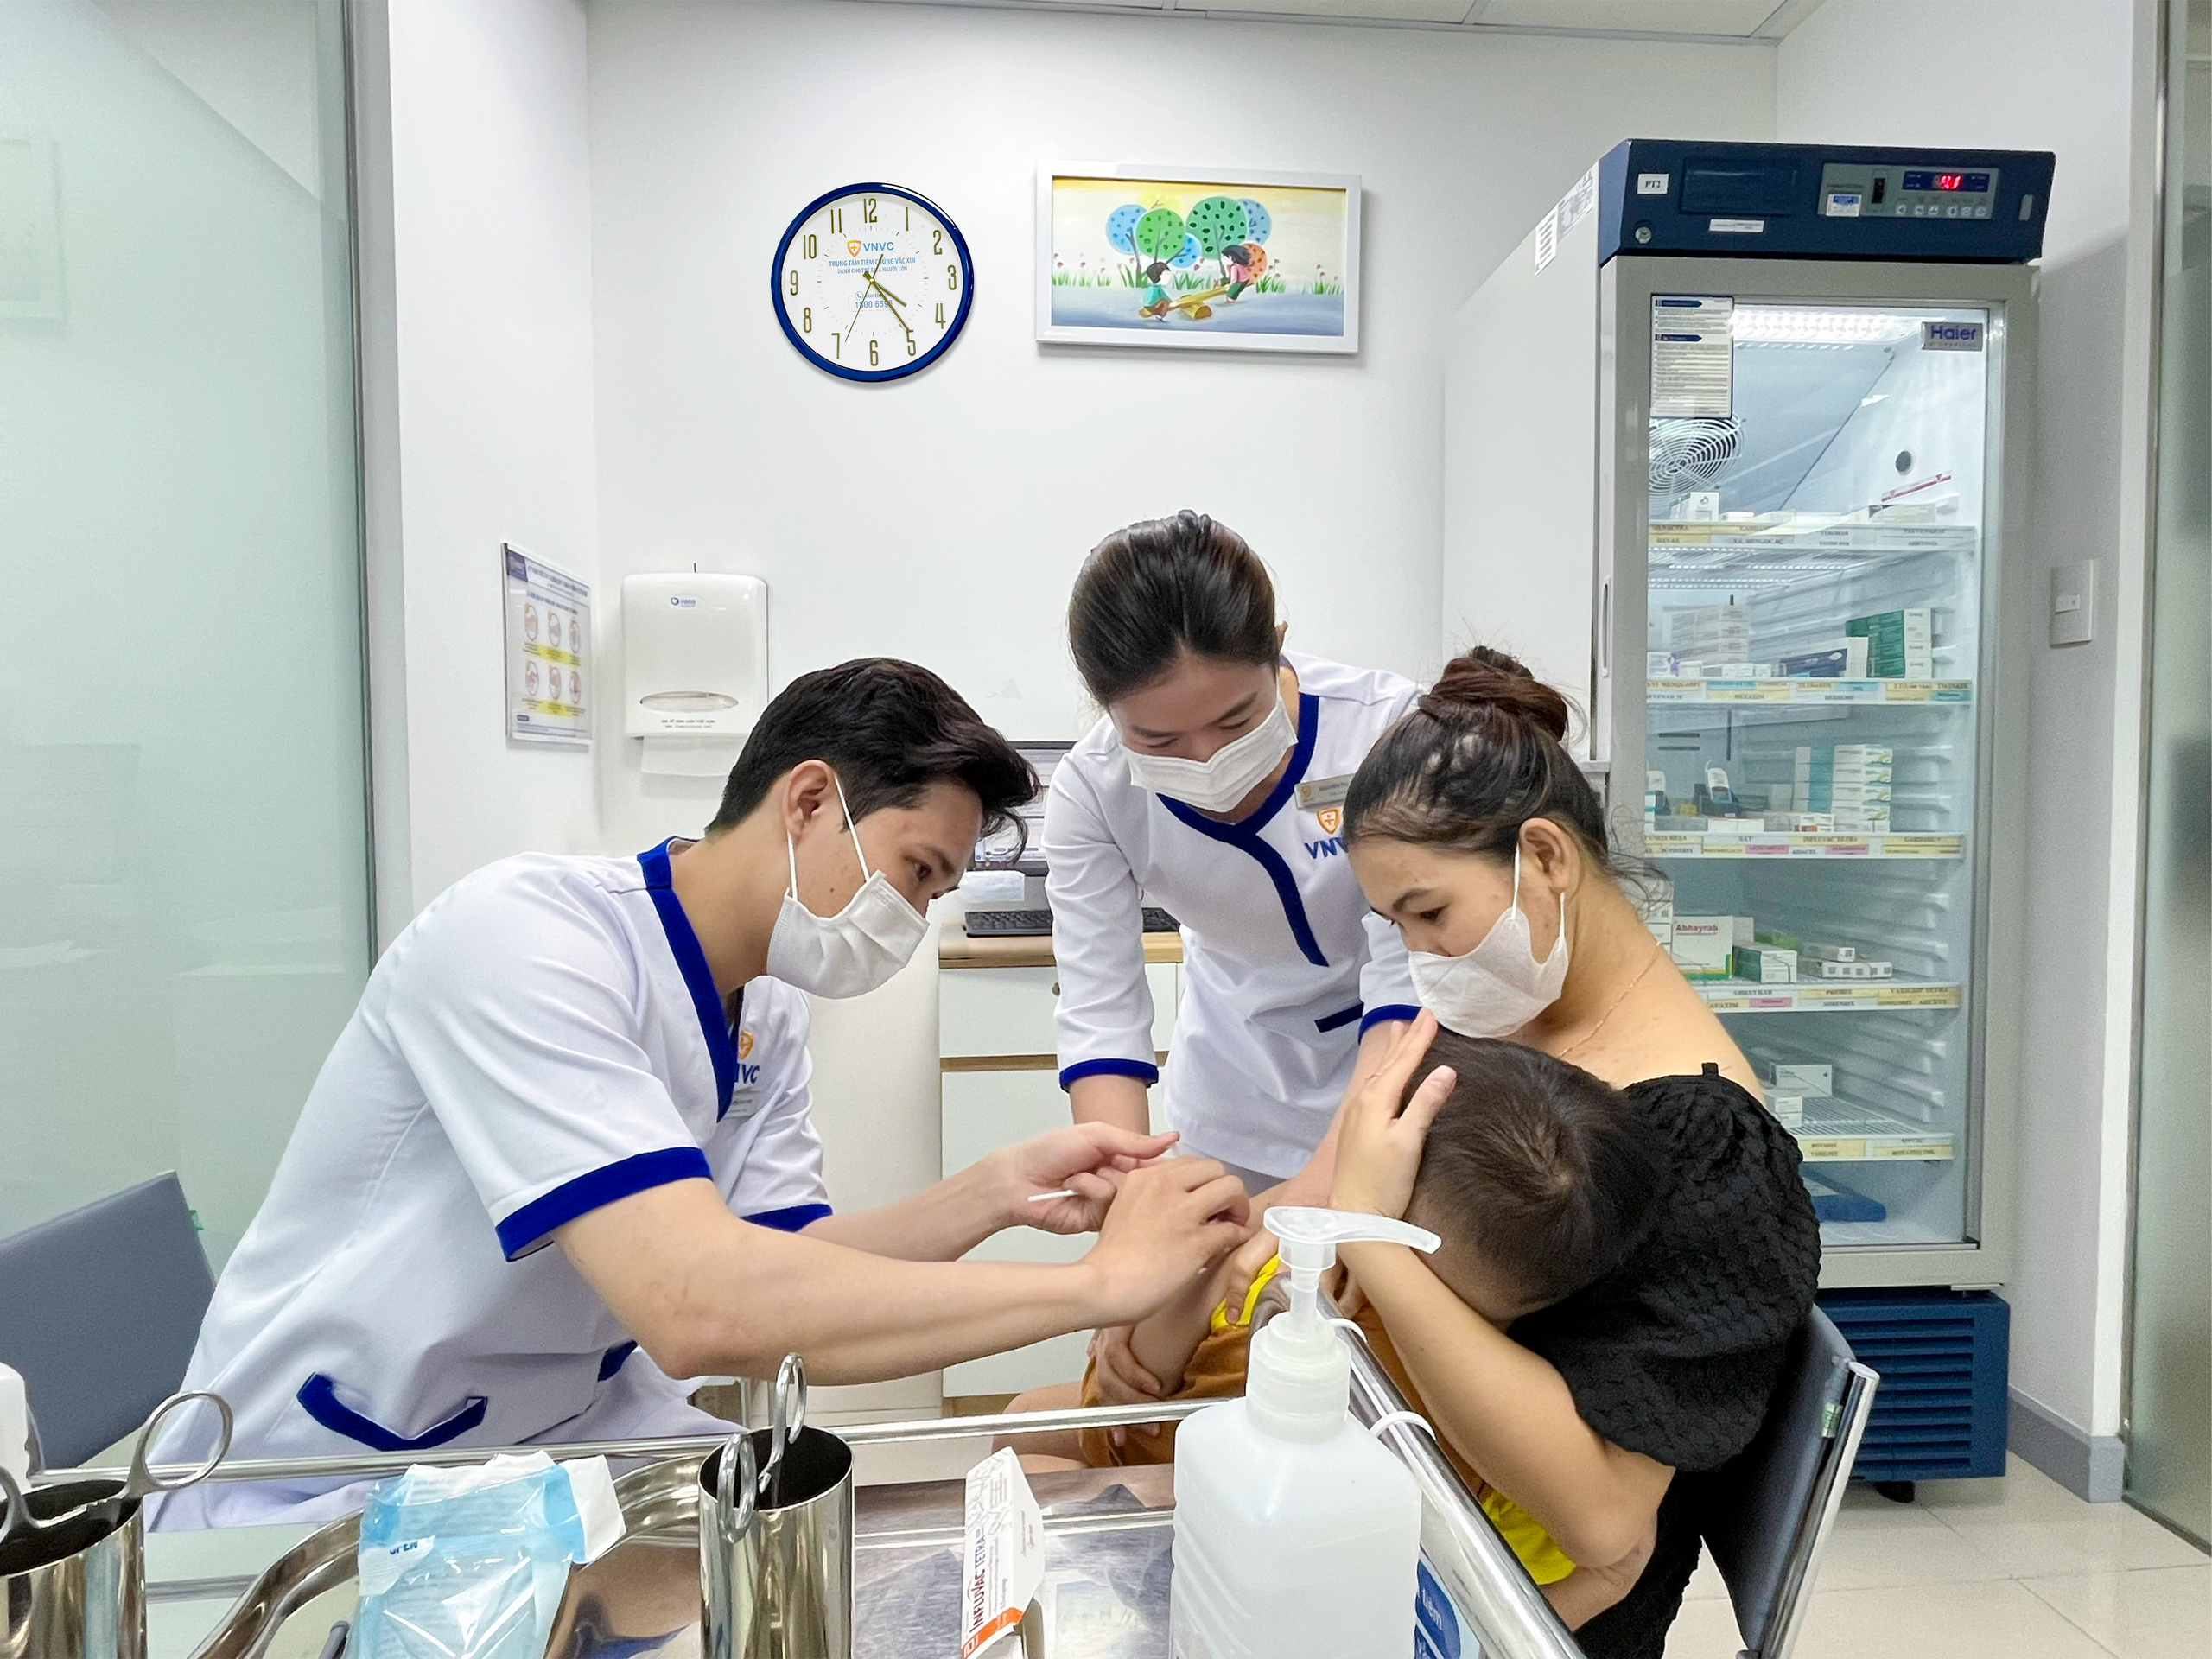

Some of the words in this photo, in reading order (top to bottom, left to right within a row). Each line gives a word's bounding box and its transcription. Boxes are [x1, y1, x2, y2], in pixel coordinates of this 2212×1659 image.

[1645, 180, 1661, 188] PT2
[830, 208, 842, 234] 11
[863, 198, 878, 223] 12
[905, 207, 909, 231] 1
[803, 234, 817, 260] 10
[863, 242, 894, 251] VNVC
[932, 229, 943, 255] 2
[790, 270, 798, 296] 9
[947, 264, 957, 290] 3
[803, 307, 812, 333] 8
[935, 302, 946, 329] 4
[906, 329, 916, 356] 5
[1931, 325, 1976, 340] Haier
[831, 333, 841, 359] 7
[869, 340, 879, 366] 6
[1305, 836, 1349, 859] VNV
[1675, 923, 1719, 932] Abhayrab
[735, 1064, 760, 1084] VC
[974, 1534, 985, 1569] TETRA
[969, 1569, 985, 1633] INFLUVAC
